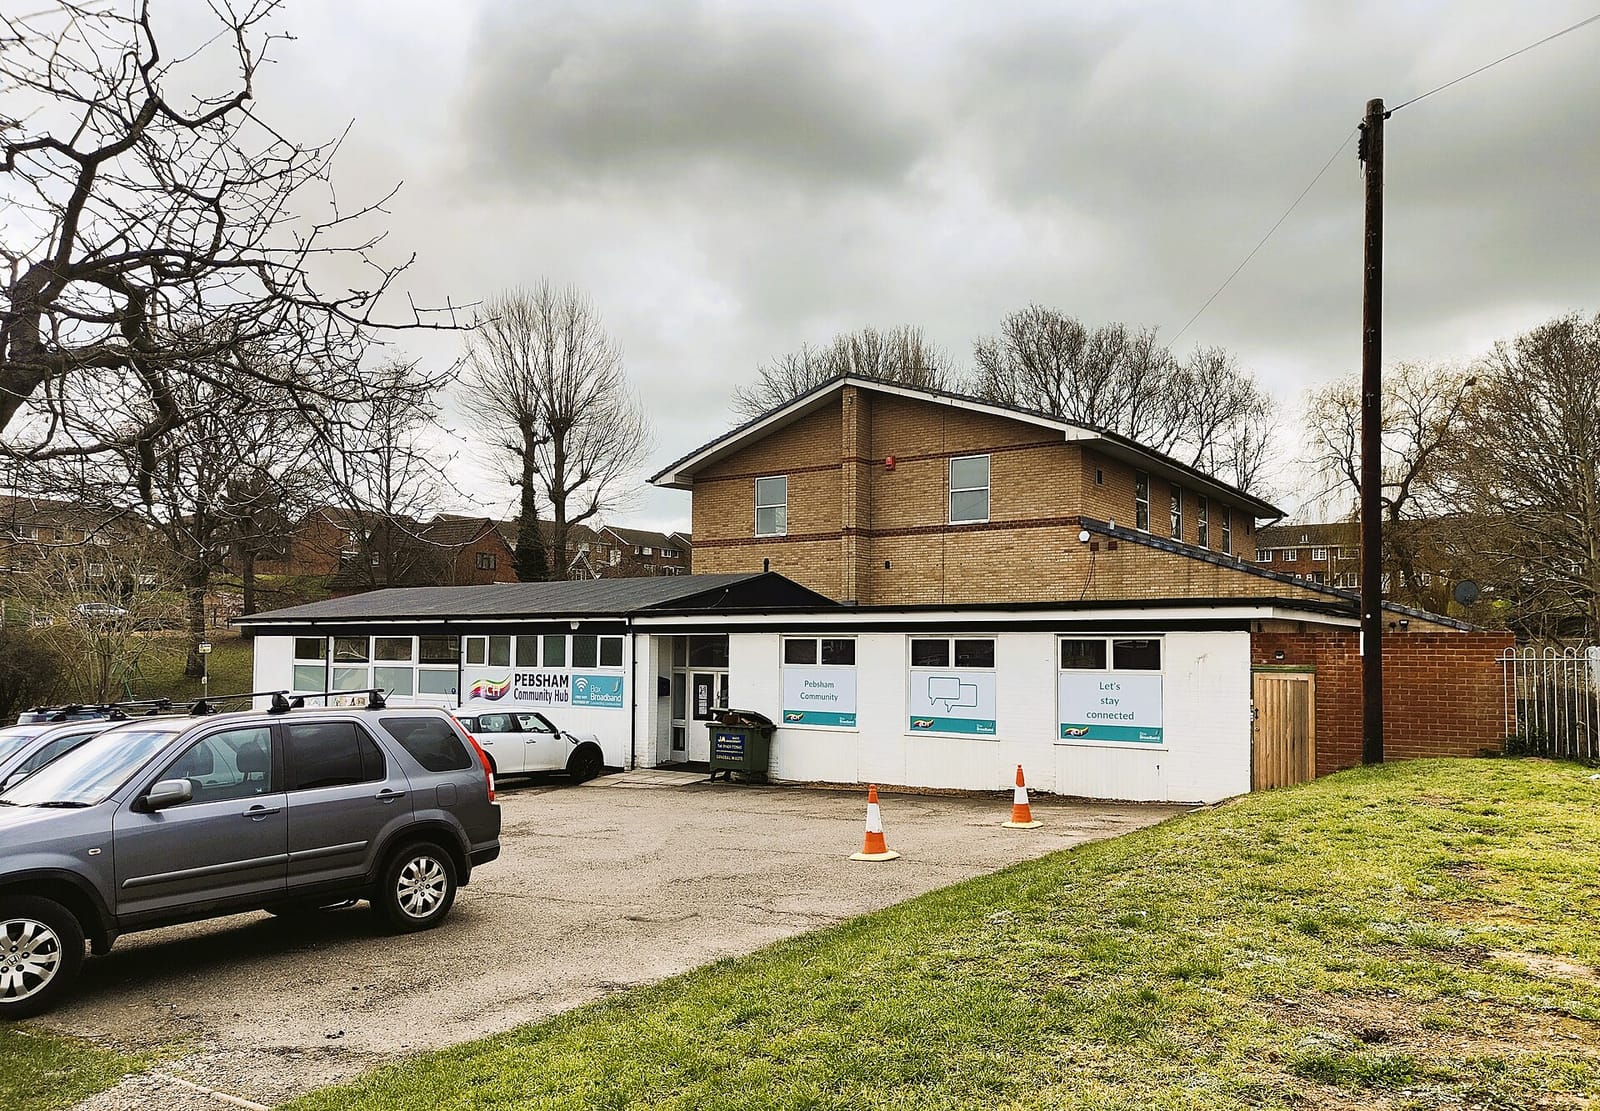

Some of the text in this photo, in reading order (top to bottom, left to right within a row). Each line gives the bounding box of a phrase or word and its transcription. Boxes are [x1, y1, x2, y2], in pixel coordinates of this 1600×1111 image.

[514, 673, 569, 688] PEBSHAM
[804, 680, 834, 688] Pebsham
[1099, 682, 1120, 690] Let's
[514, 688, 569, 704] Community Hub
[590, 692, 622, 702] Broadband
[800, 692, 838, 702] Community
[1100, 698, 1120, 706] stay
[1086, 712, 1134, 720] connected
